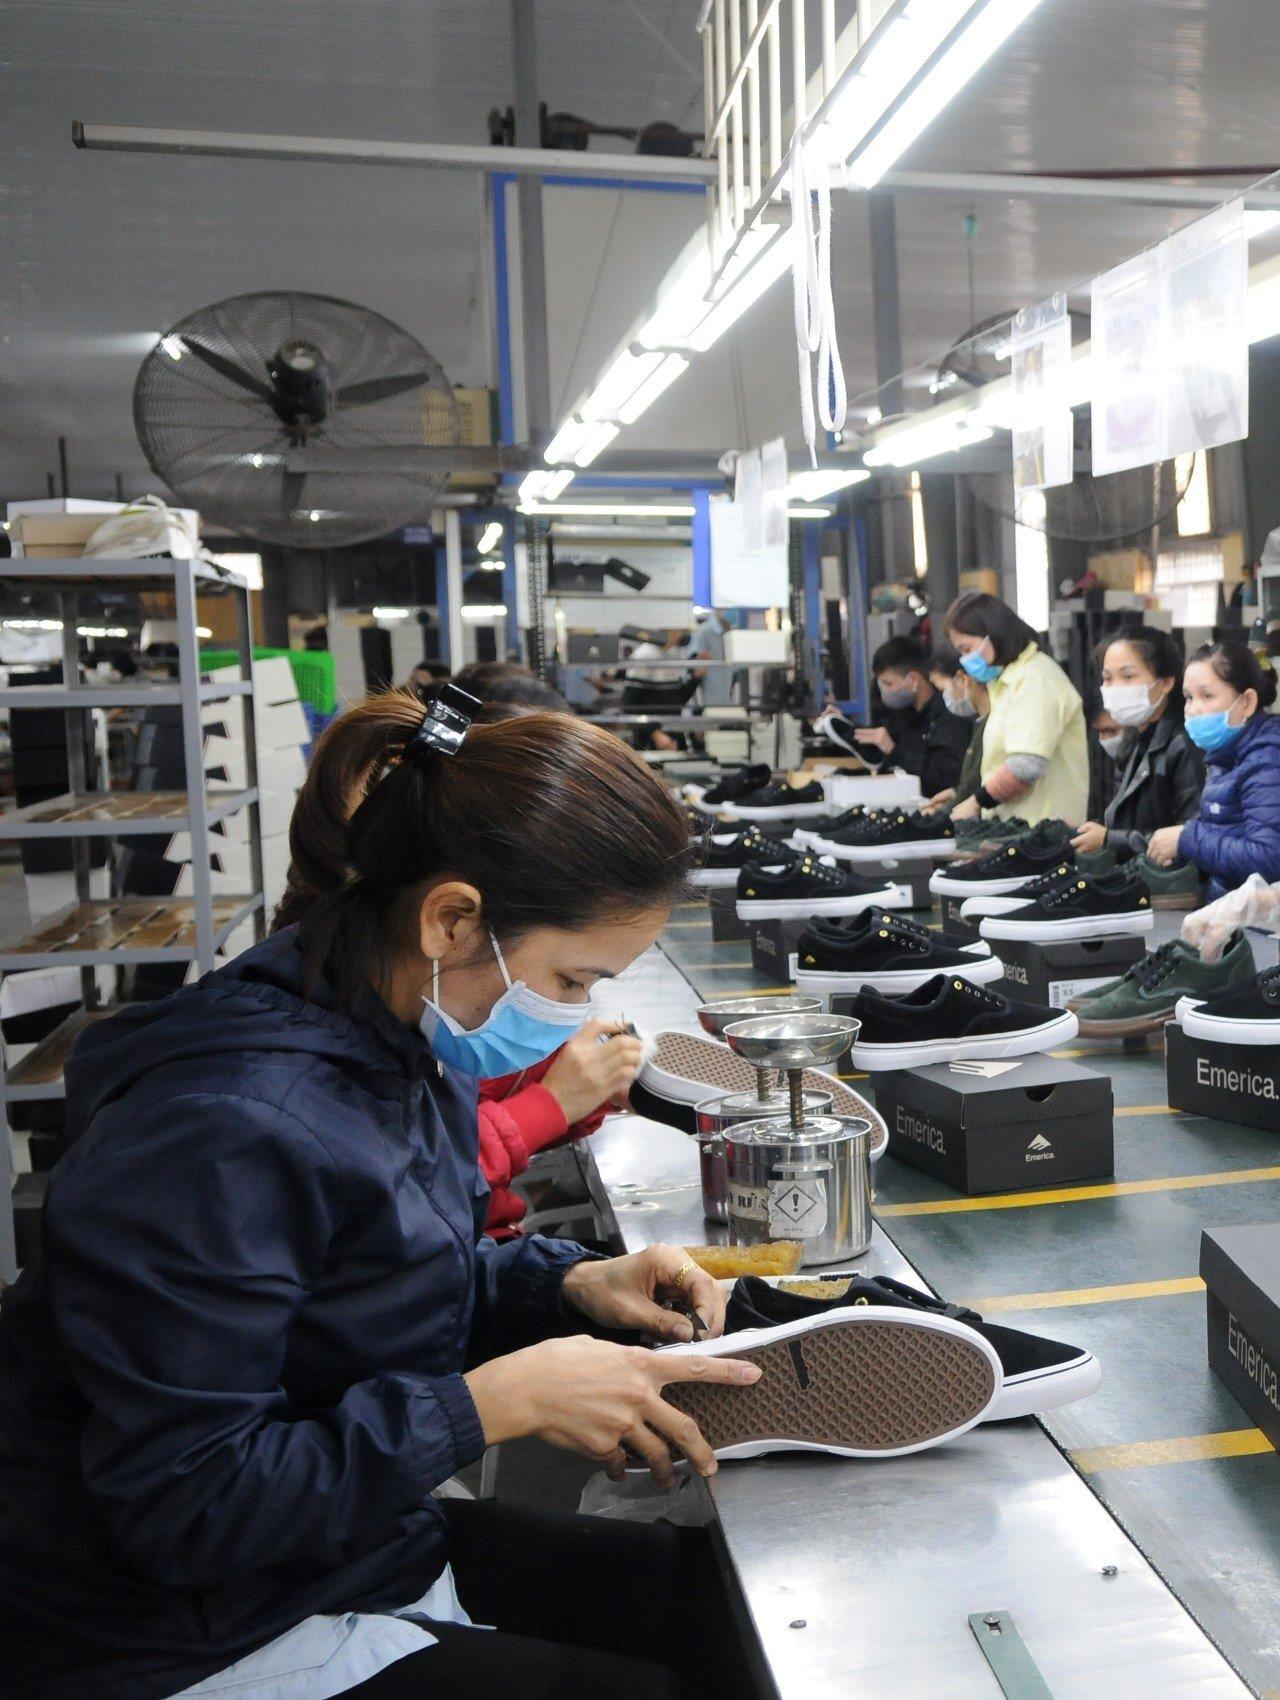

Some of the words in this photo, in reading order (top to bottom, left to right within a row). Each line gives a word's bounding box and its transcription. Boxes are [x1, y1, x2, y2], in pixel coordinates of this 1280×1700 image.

[1197, 1058, 1280, 1100] Emerica.
[896, 1105, 946, 1155] Emerica.
[1025, 1152, 1056, 1162] Emerica.
[1228, 1313, 1280, 1412] Emerica.
